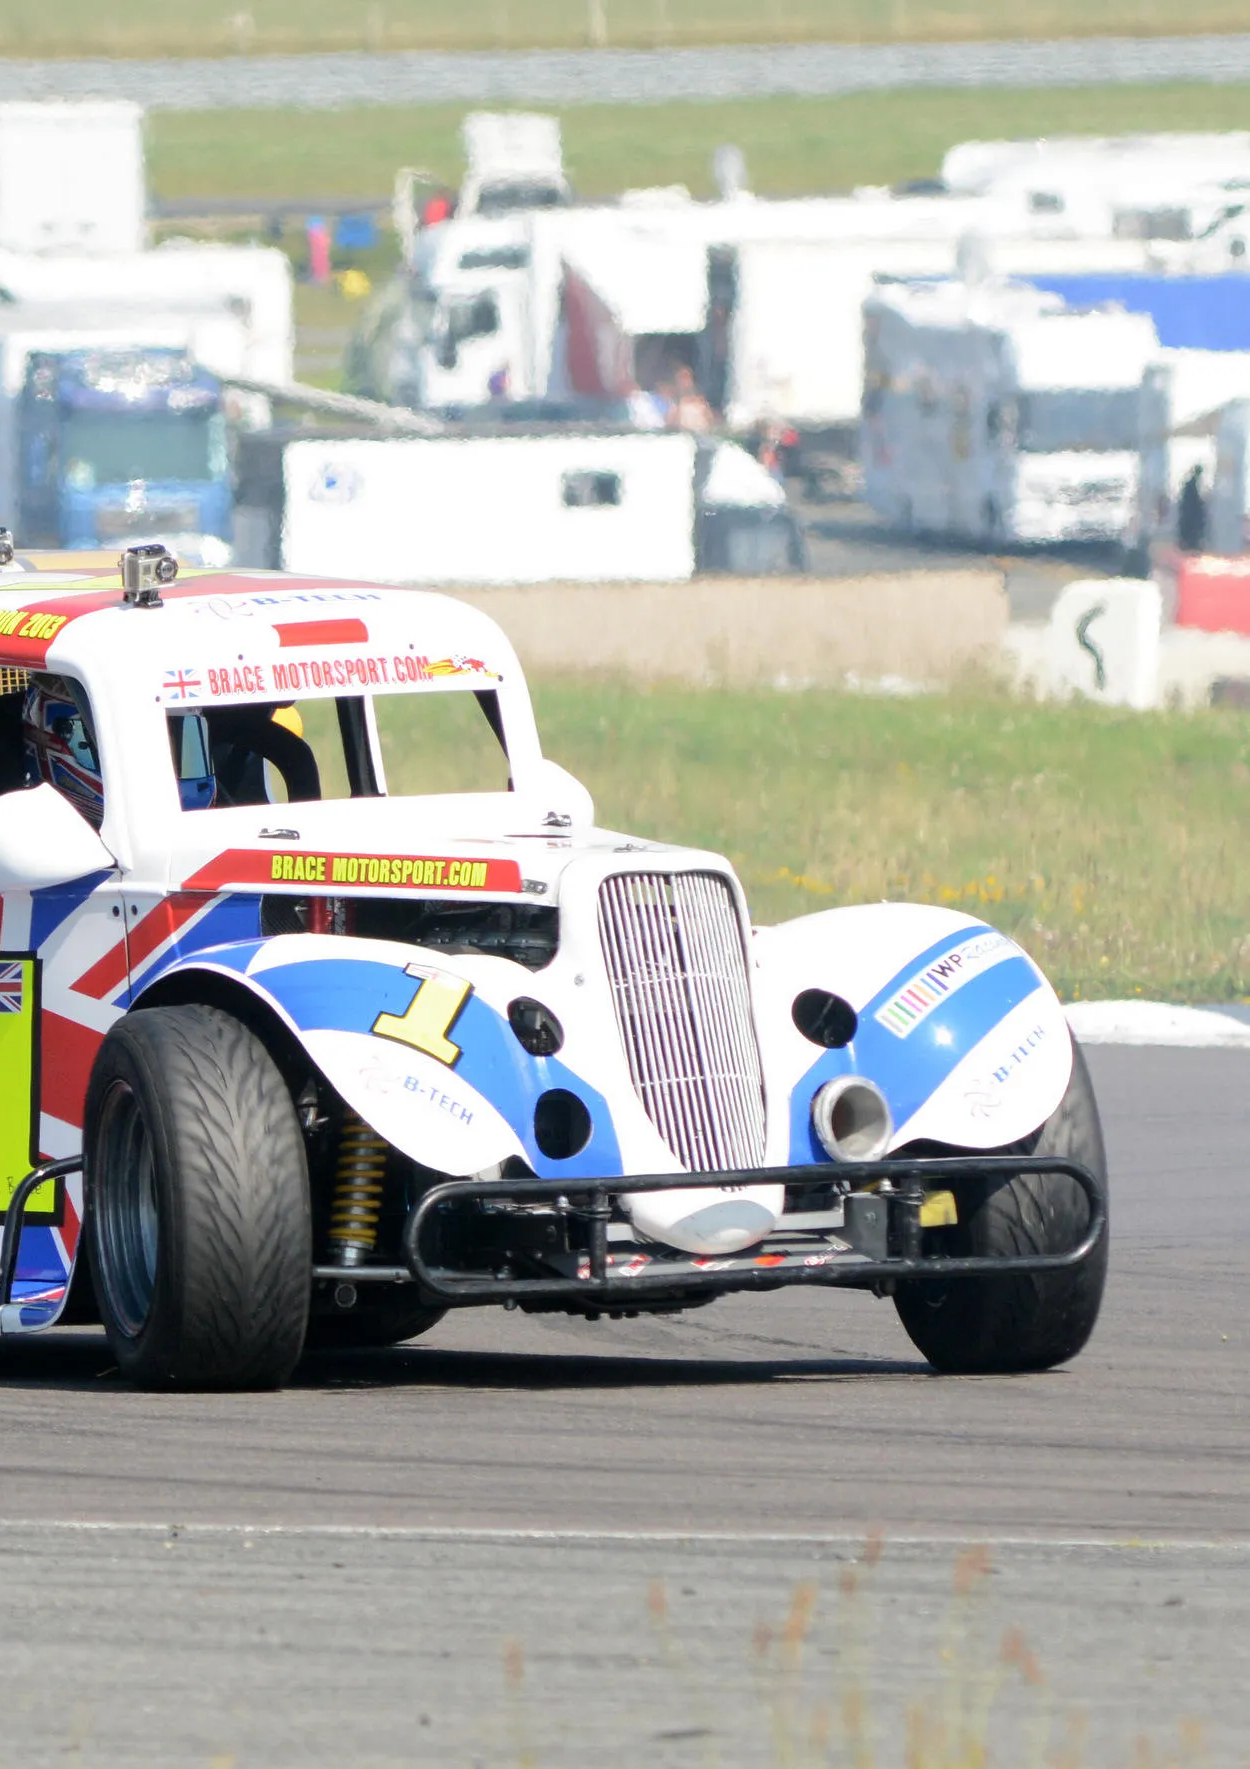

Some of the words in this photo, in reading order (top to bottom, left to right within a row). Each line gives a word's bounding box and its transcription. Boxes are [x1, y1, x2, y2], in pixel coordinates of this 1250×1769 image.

[17, 611, 67, 641] 2013
[207, 664, 266, 697] BRACE
[270, 655, 434, 691] MOTORSPORT.COM
[270, 854, 327, 882] BRACE
[332, 857, 488, 888] MOTORSPORT.COM
[930, 953, 963, 978] WP
[369, 962, 476, 1071] 1
[992, 1024, 1046, 1084] B-TECH
[403, 1075, 475, 1126] B-TECH
